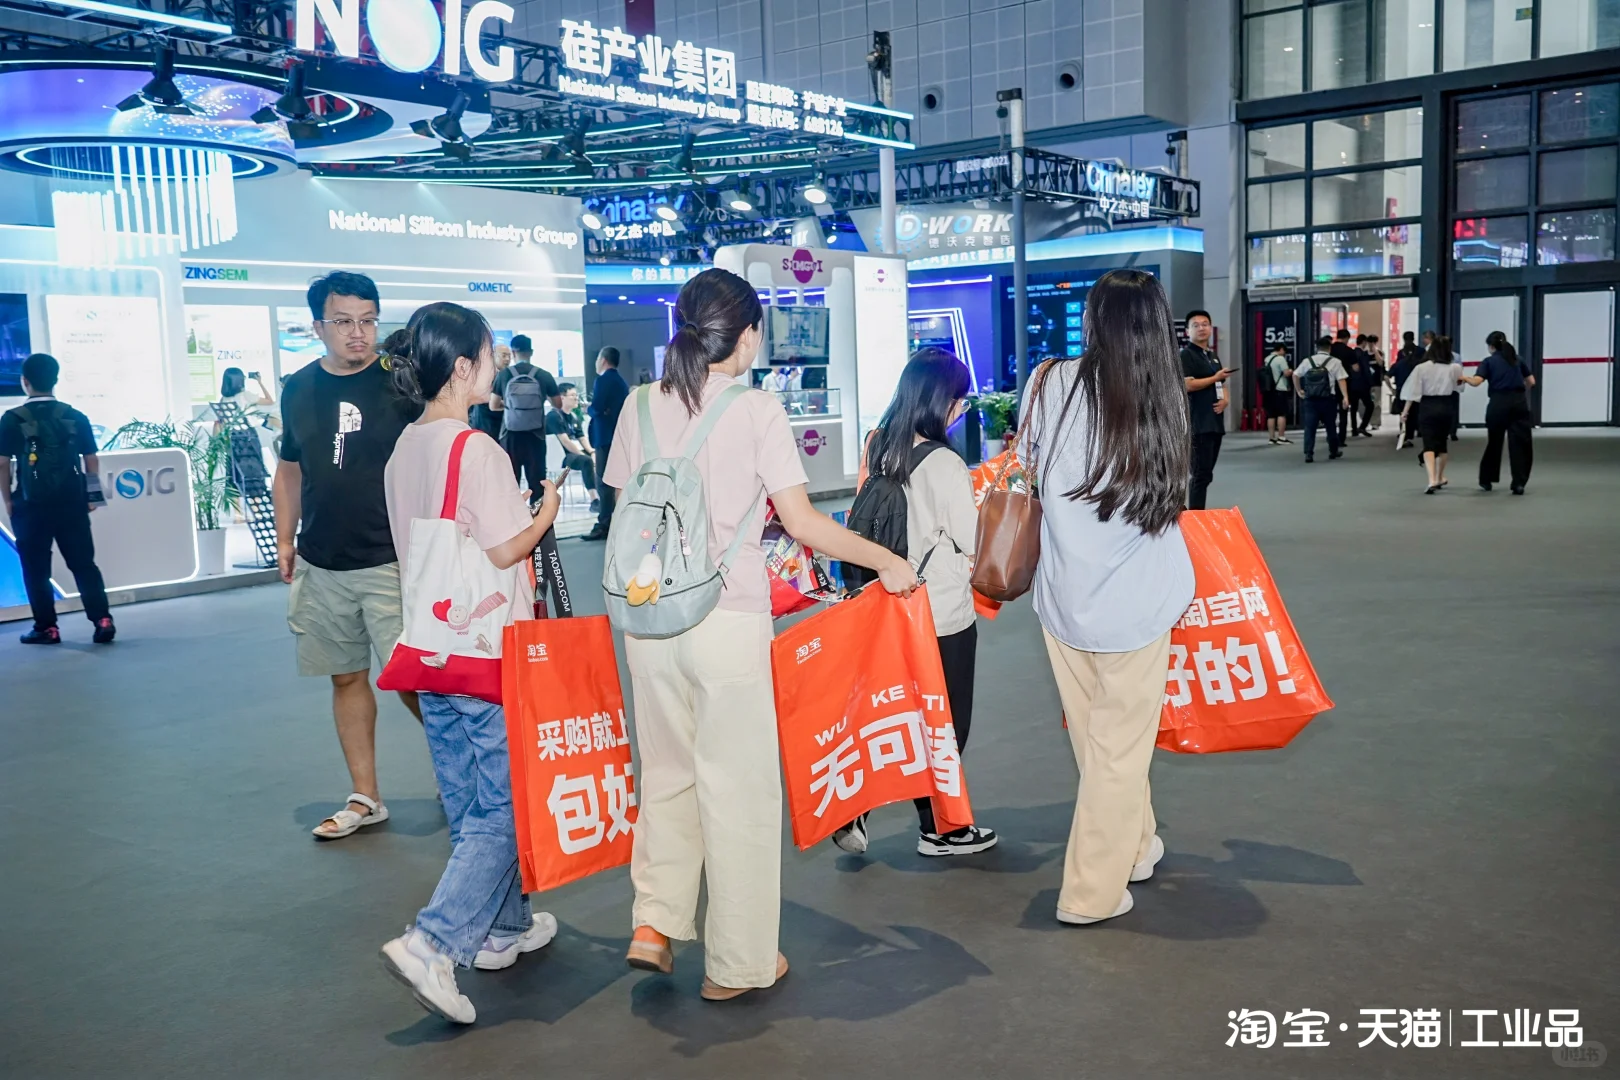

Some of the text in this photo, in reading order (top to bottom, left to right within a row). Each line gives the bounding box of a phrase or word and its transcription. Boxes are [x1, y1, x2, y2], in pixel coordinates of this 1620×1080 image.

[561, 19, 737, 99] 硅产业集团
[558, 75, 741, 123] National Silicon Industry Group
[328, 209, 578, 249] National Silicon Industry Group
[185, 266, 248, 281] ZINGSEMI
[468, 281, 513, 294] OKMETIC
[333, 432, 344, 465] Supreme
[548, 550, 571, 612] TAOBAO.COM
[527, 643, 548, 657] 淘宝
[796, 637, 821, 661] 淘宝
[814, 684, 945, 747] WU KE TI
[809, 708, 961, 818] 无可替
